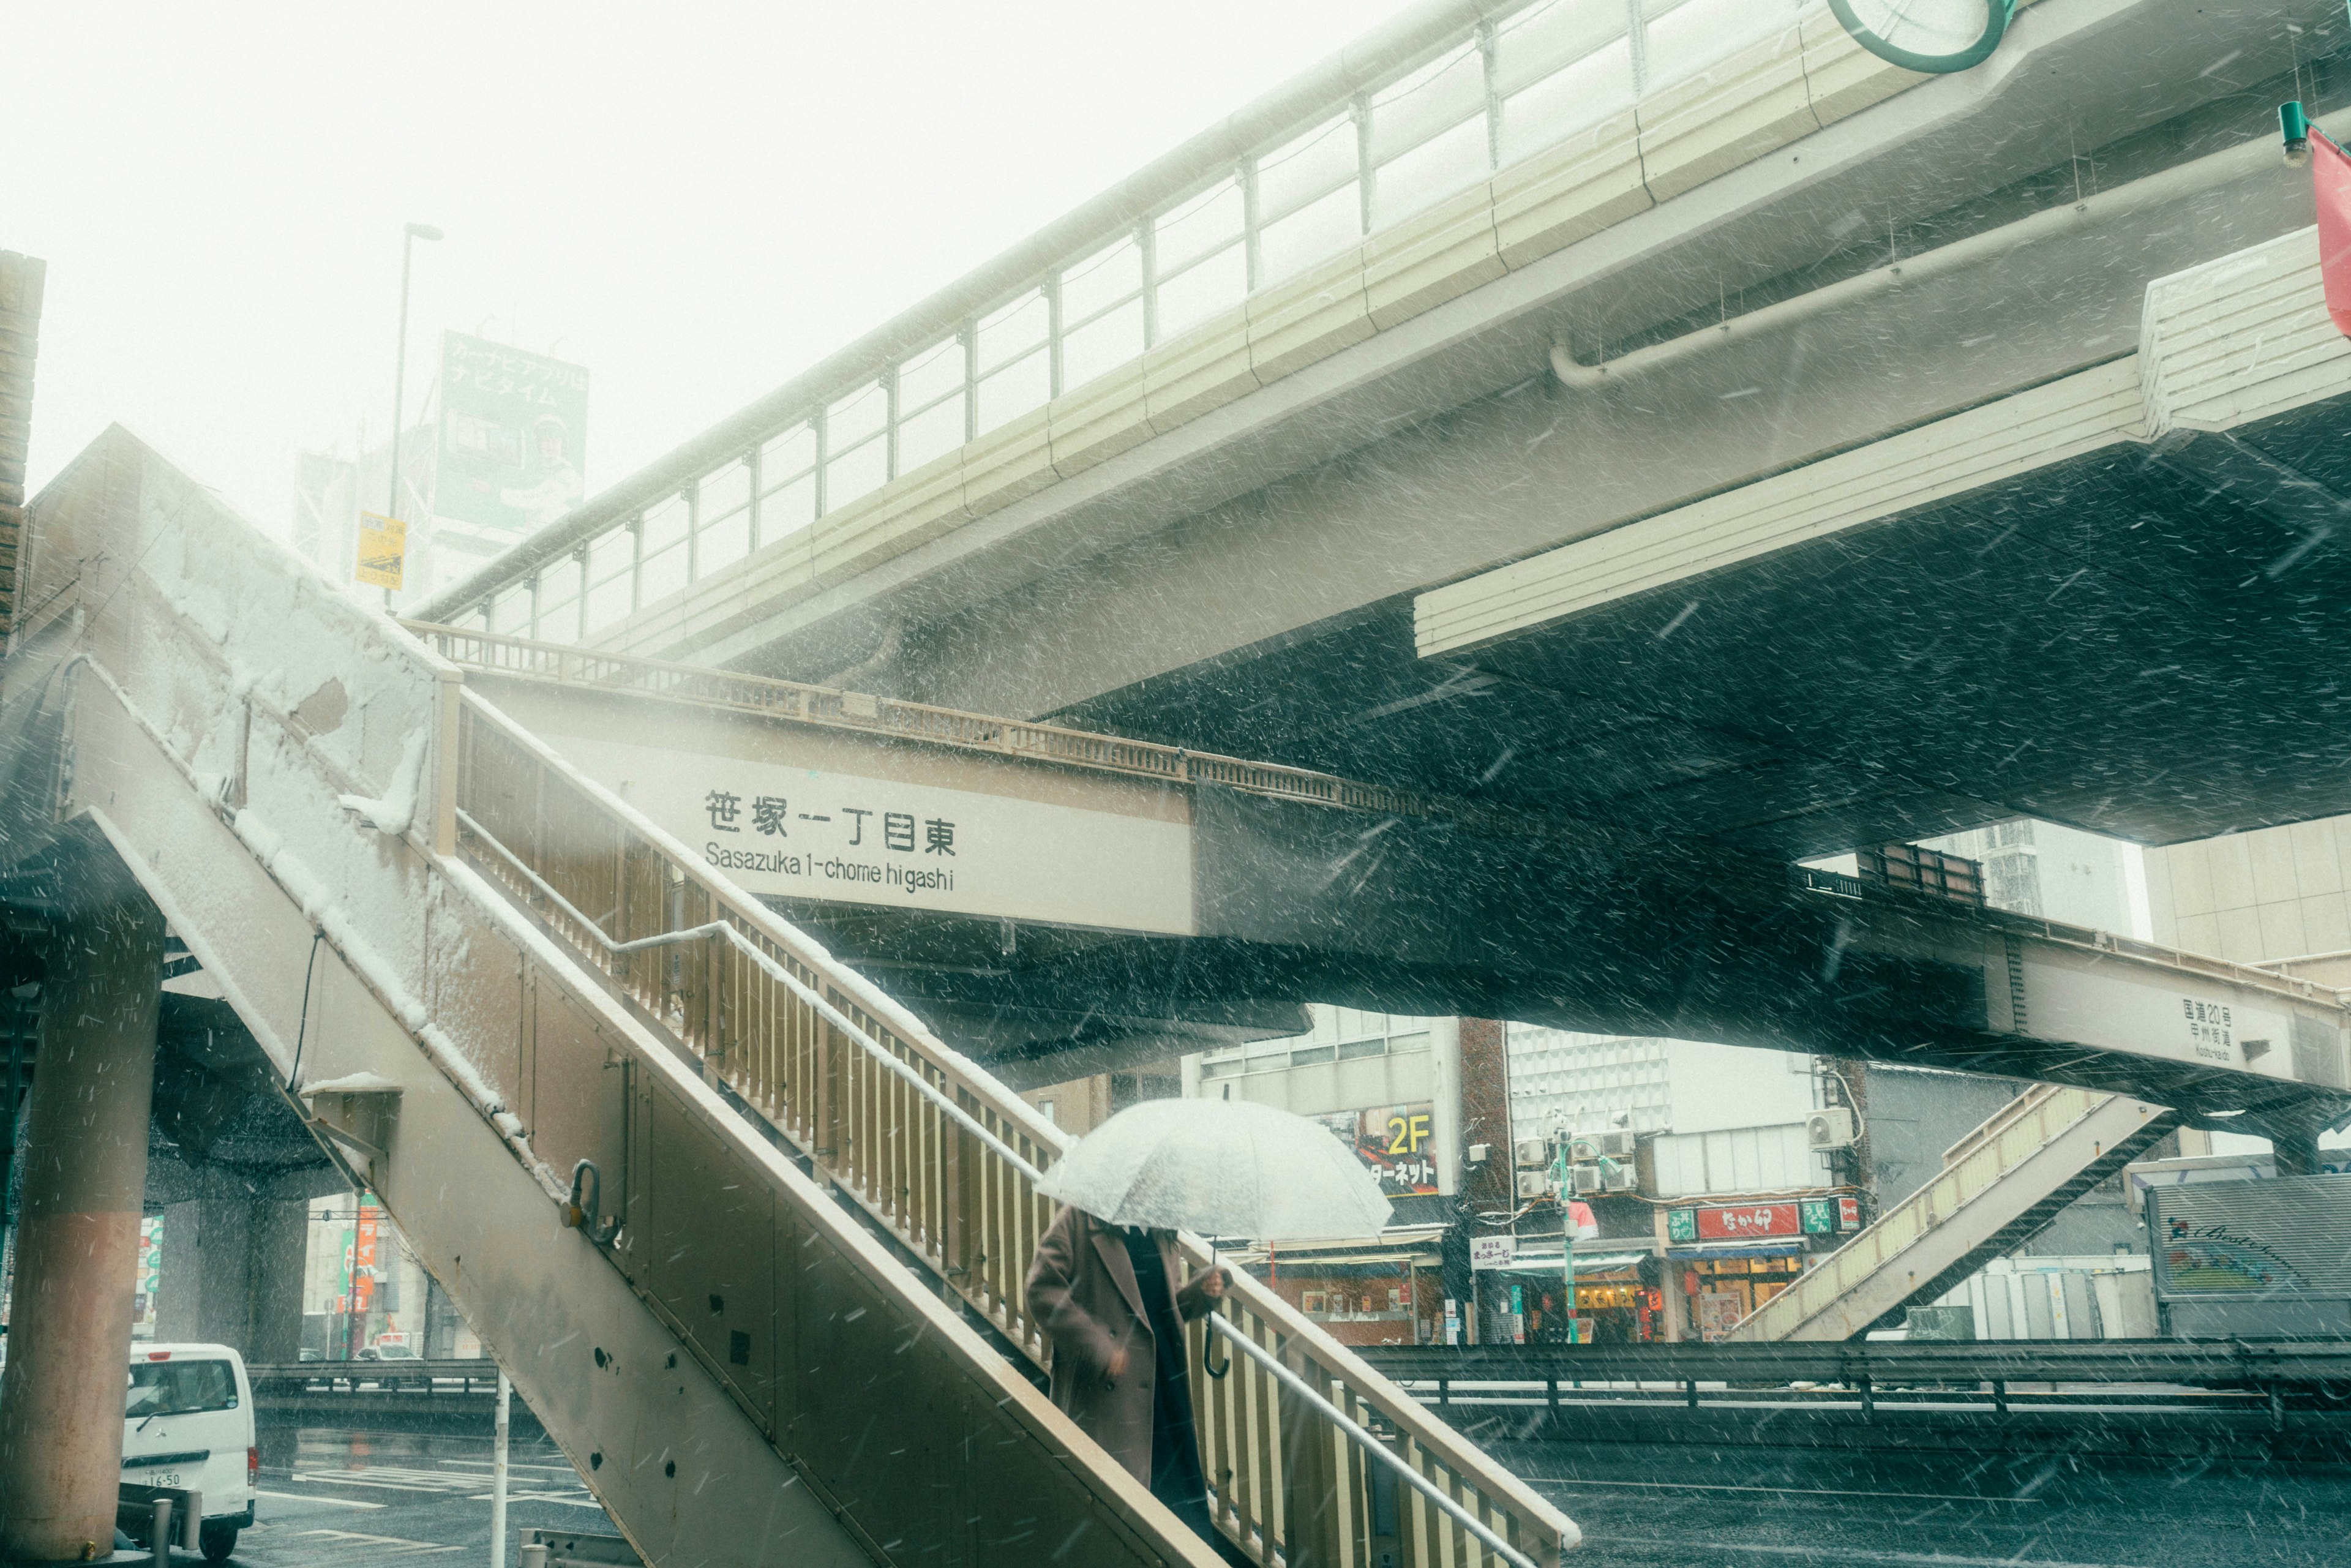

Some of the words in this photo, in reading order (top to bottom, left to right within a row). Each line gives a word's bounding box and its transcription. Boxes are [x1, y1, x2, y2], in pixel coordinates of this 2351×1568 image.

[449, 364, 558, 408] ナビタイム
[704, 789, 957, 857] 笹塚一丁目東
[705, 841, 801, 876] Sasazuka
[807, 853, 882, 883] 1-chome
[886, 862, 954, 895] higashi
[2183, 998, 2232, 1028] 国道20号
[2190, 1022, 2232, 1047] 甲州街道
[1388, 1114, 1430, 1154] 2F
[1721, 1209, 1773, 1233] なか卯
[1473, 1249, 1510, 1259] まっさーじ
[150, 1474, 180, 1487] 16-50
